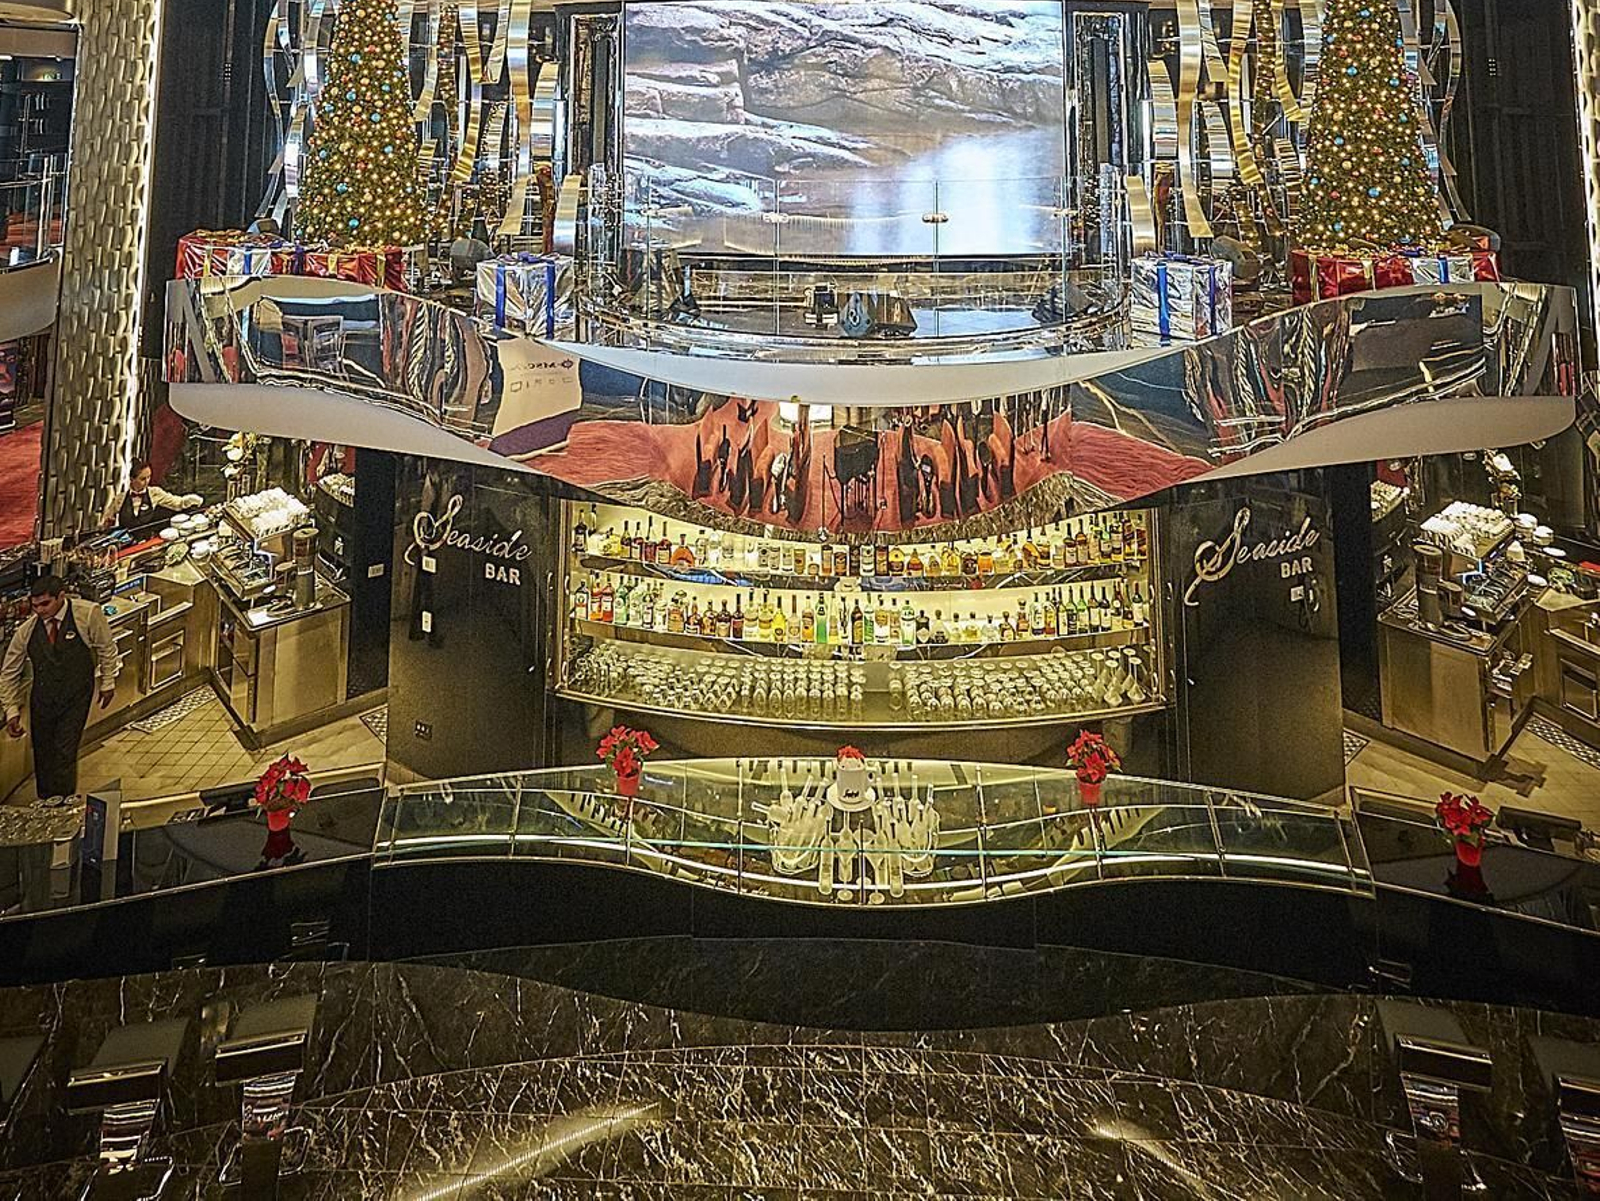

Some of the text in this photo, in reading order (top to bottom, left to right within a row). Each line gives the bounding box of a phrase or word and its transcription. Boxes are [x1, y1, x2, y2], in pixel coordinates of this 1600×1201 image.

[404, 494, 532, 566] Seaside
[485, 562, 521, 586] BAR
[1184, 506, 1321, 607] Seaside
[1280, 556, 1314, 579] BAR
